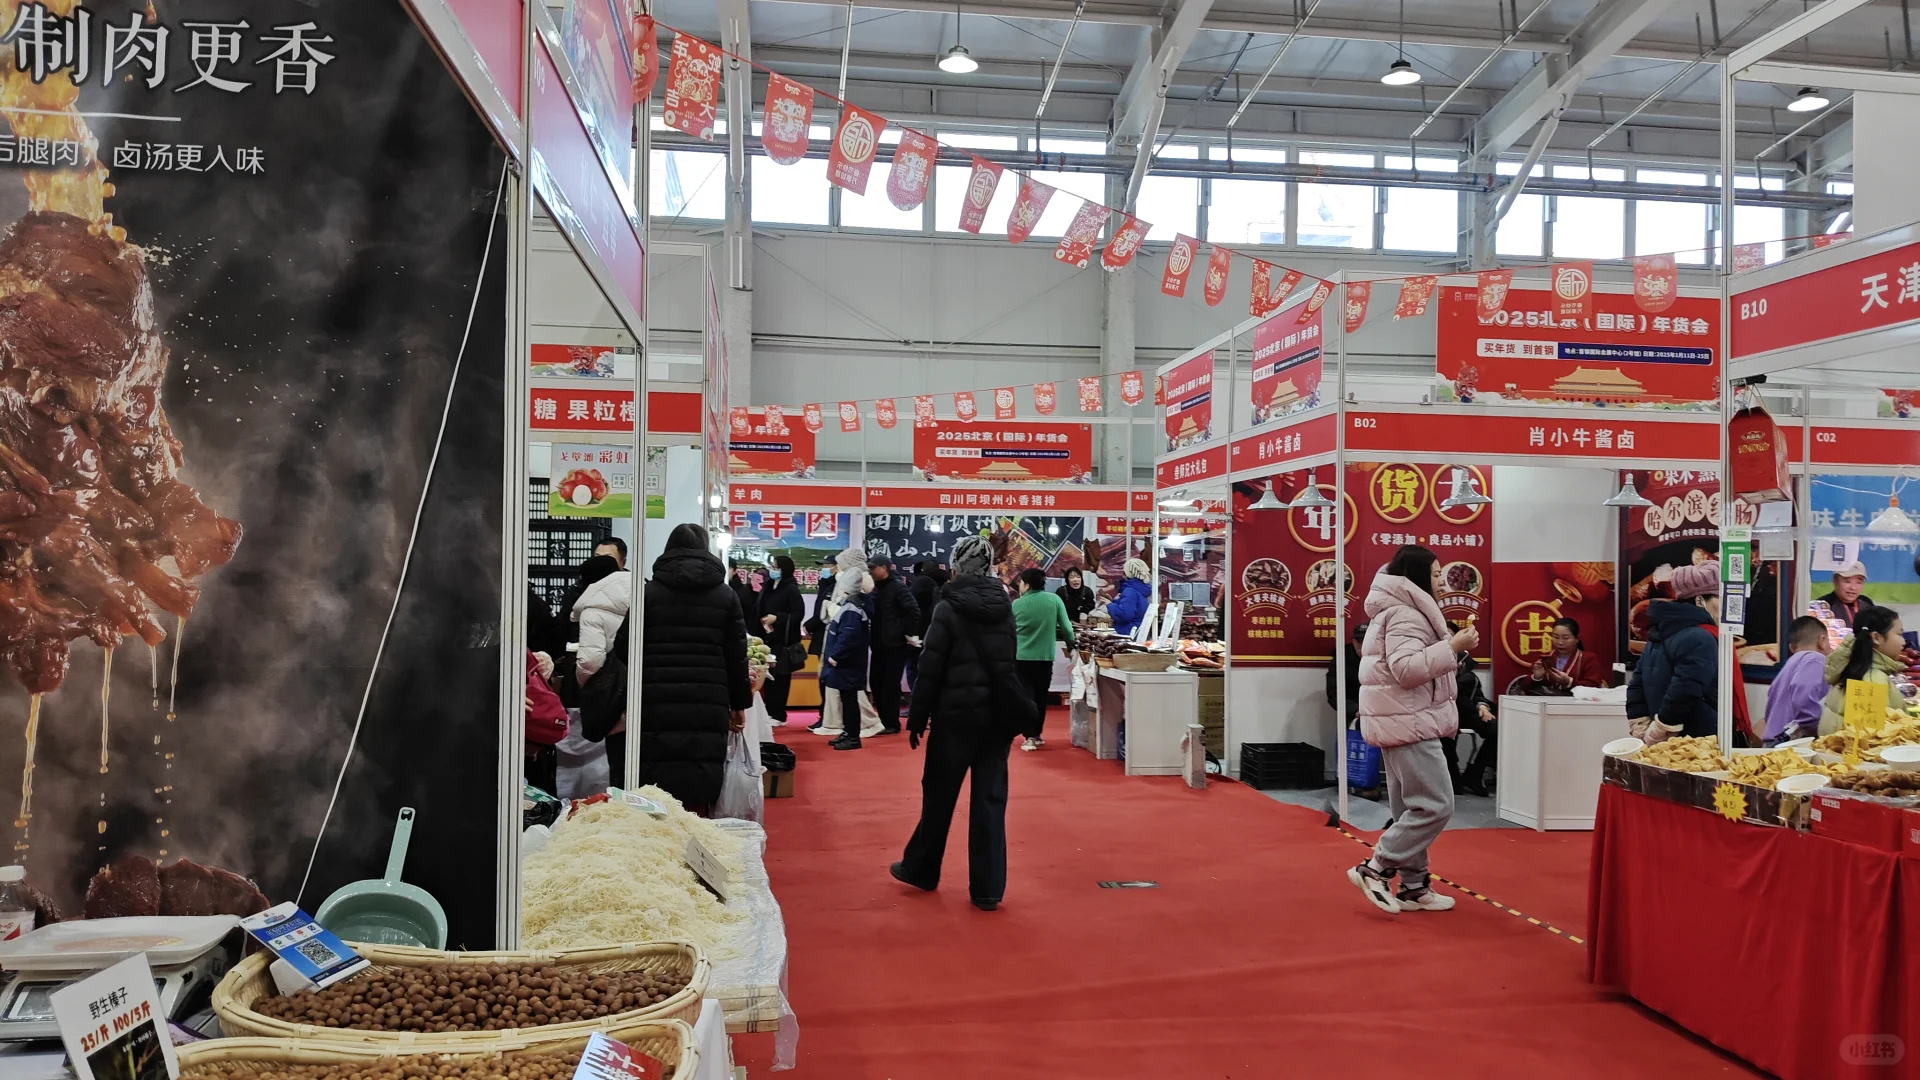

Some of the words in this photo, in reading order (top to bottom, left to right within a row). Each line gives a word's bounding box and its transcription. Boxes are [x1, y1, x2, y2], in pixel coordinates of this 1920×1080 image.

[3, 3, 336, 96] 制肉更香
[1860, 261, 1920, 314] 天津
[1741, 298, 1767, 320] B10
[1477, 309, 1711, 339] 025北（国际）年货会
[1483, 343, 1516, 358] 买年货
[1522, 345, 1554, 360] 到首钢
[533, 398, 558, 421] 糖
[1354, 416, 1378, 430] B02
[1258, 432, 1302, 461] 肖小牛酱卤
[1528, 427, 1635, 452] 肖小牛酱卤
[1815, 432, 1837, 443] C02
[599, 450, 629, 464] 彩虹
[733, 487, 763, 502] 羊肉
[869, 489, 884, 498] A11
[939, 493, 1056, 507] 四川阿坝州小香猪排
[1134, 493, 1149, 502] A10
[1376, 467, 1420, 515] 货
[867, 538, 966, 560] 跑山小
[1515, 611, 1555, 656] 吉
[88, 986, 129, 1021] 野生榛子
[80, 1022, 110, 1053] 25/斤
[112, 1000, 152, 1035] 100/5斤
